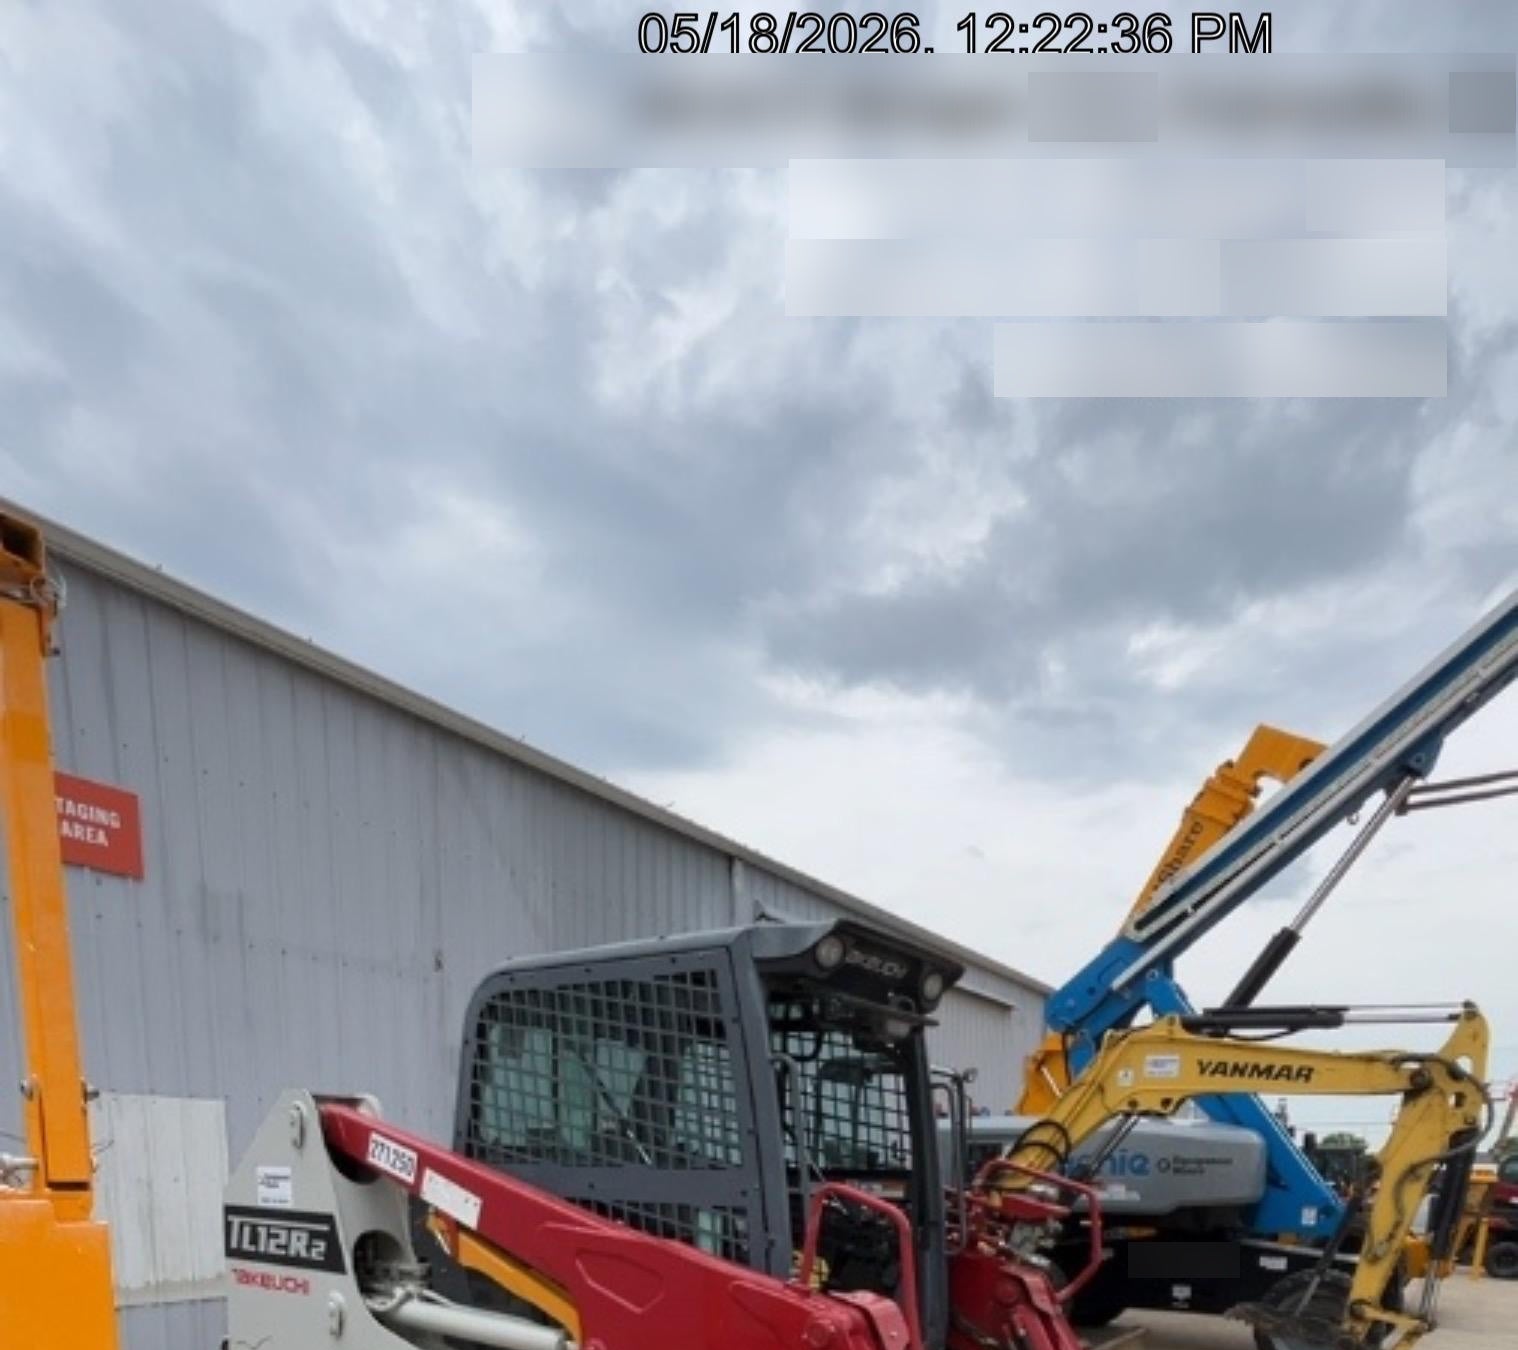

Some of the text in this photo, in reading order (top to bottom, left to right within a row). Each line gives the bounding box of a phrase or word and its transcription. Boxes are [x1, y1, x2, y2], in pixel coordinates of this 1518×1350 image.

[55, 797, 121, 829] TAGING
[62, 819, 109, 847] AREA
[1196, 1058, 1315, 1084] YANMAR
